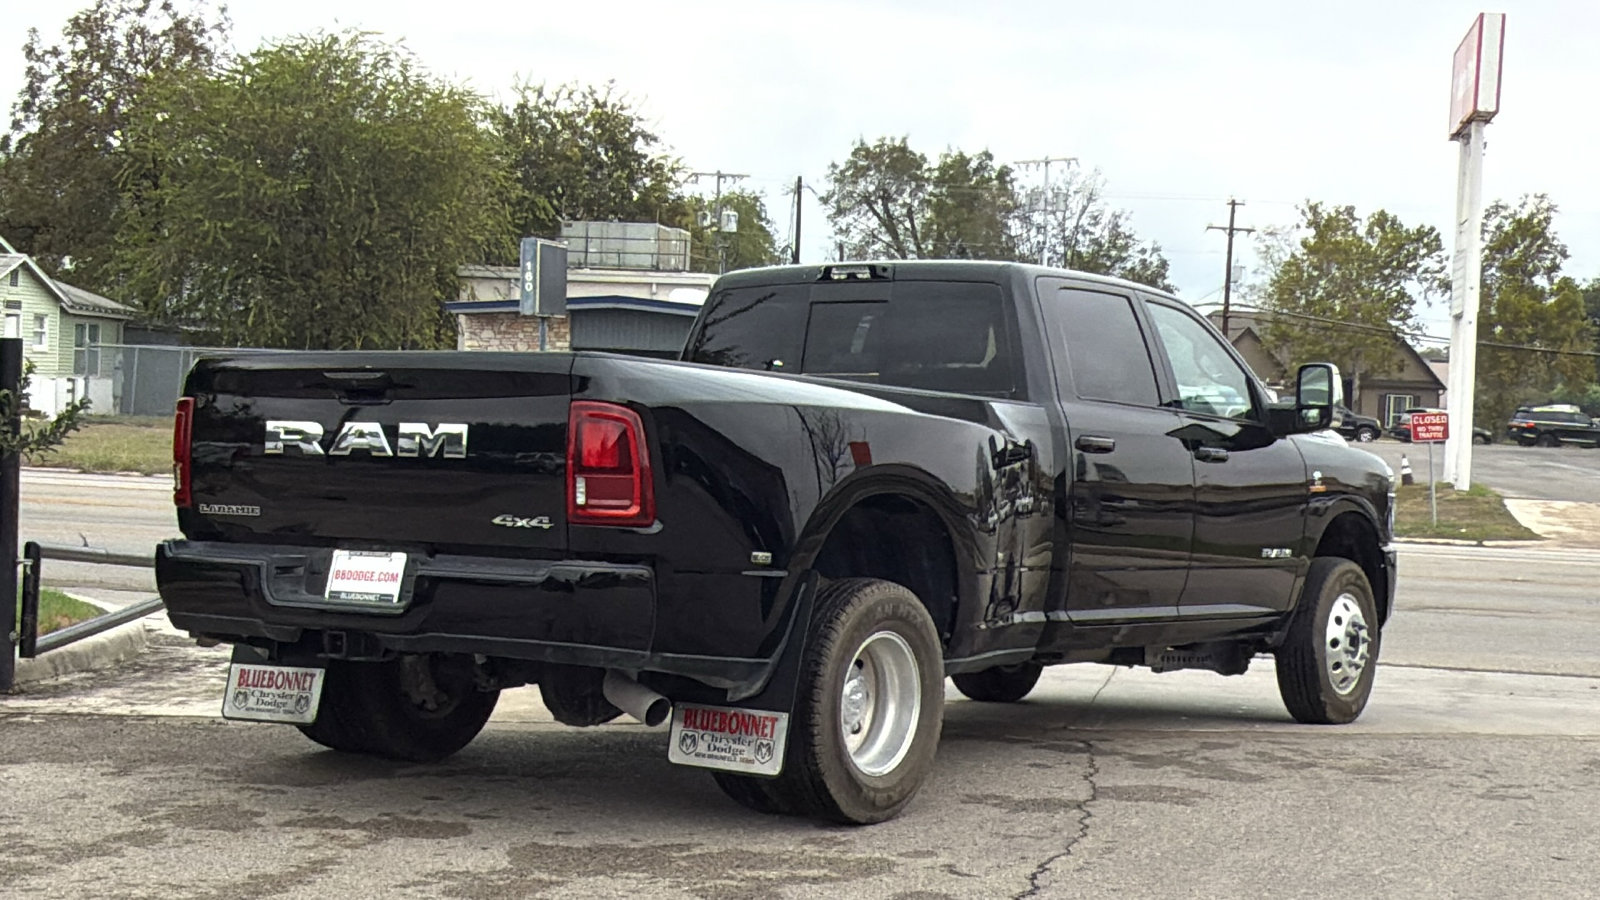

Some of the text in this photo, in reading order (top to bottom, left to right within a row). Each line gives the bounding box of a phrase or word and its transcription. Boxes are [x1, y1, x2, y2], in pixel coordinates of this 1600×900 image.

[525, 261, 533, 292] 160
[1413, 415, 1447, 424] CLOSED
[265, 421, 468, 459] RAM
[199, 504, 260, 516] LARAMIE
[1262, 548, 1292, 558] RAM
[334, 569, 399, 583] BBDODGE.COM
[238, 668, 316, 691] BLUEBONNET
[251, 689, 295, 700] Chrysler
[256, 698, 288, 708] Dodge
[683, 708, 778, 739] BLUEBONNET
[700, 732, 754, 747] Chrysler
[707, 743, 746, 756] Dodge
